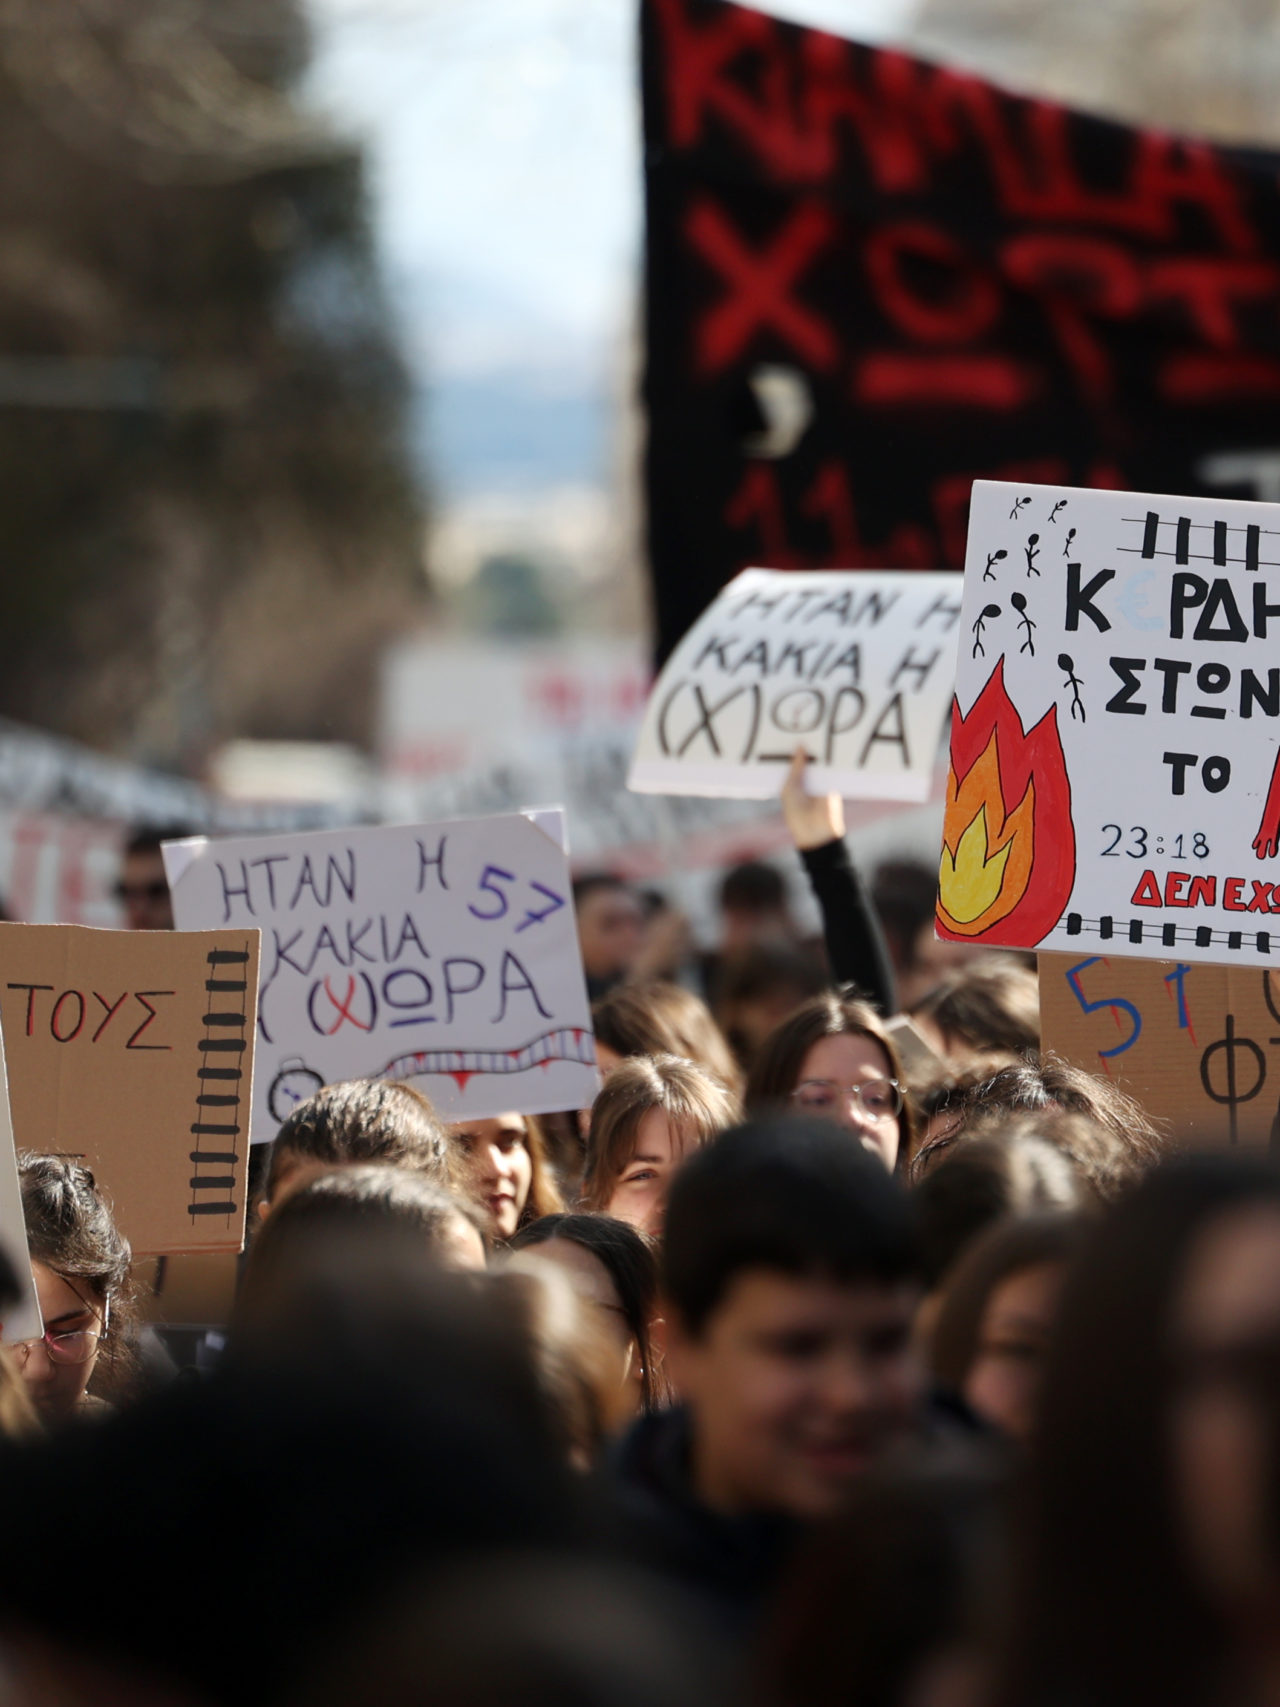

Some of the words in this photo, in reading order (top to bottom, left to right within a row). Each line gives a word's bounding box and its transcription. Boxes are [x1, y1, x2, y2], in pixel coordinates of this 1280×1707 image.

[728, 588, 904, 627] ΗΤΑΝ
[693, 636, 864, 682] ΚΑΚΙΑ
[889, 646, 942, 694] Η
[1105, 656, 1280, 720] ΣΤΩΝ
[1163, 752, 1231, 795] ΤΟ
[1100, 824, 1210, 859] 23:18
[214, 848, 357, 923] ΗΤΑΝ
[415, 835, 450, 893] Η
[467, 864, 566, 933] 57
[270, 911, 431, 978] ΚΑΚΙΑ
[7, 983, 176, 1050] ΤΟΥΣ
